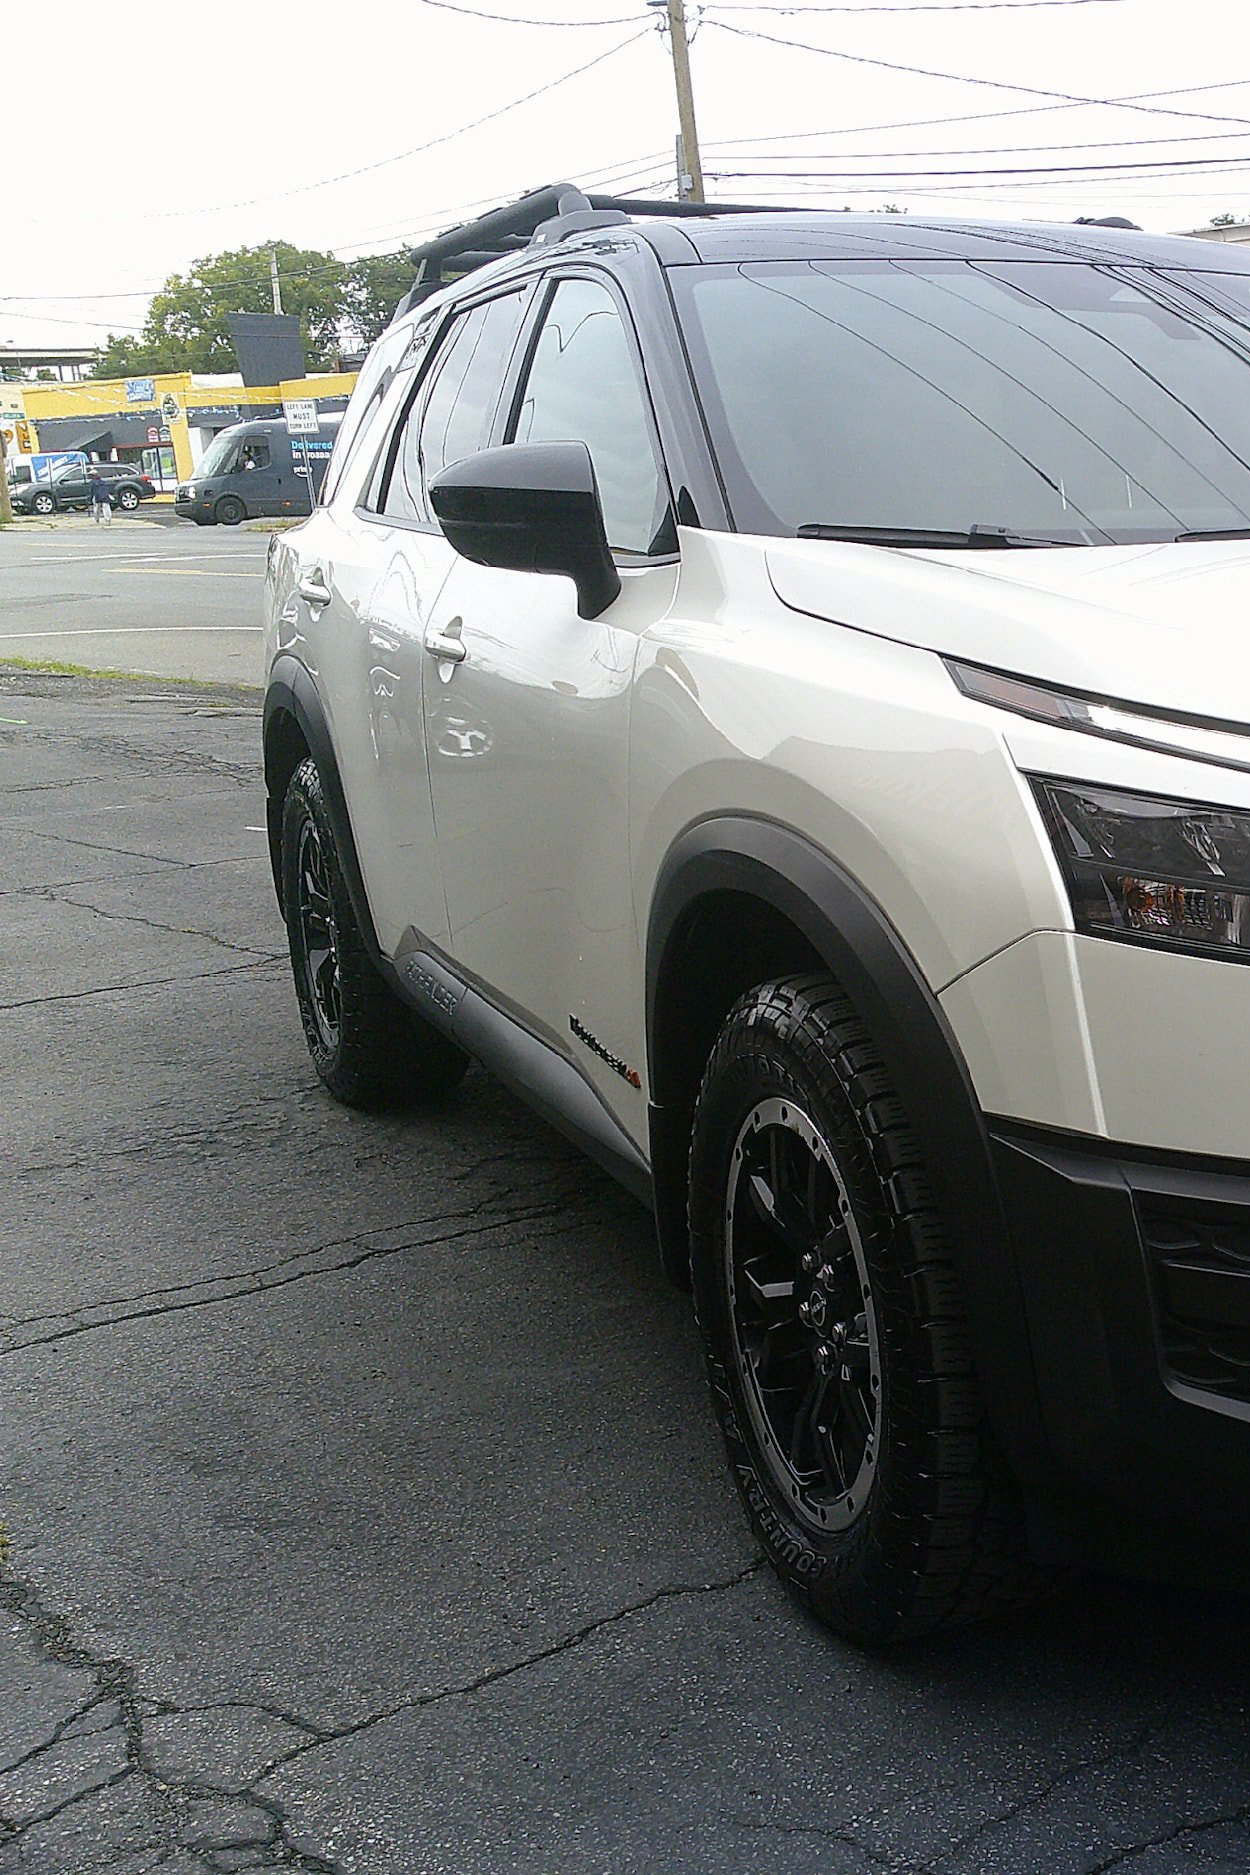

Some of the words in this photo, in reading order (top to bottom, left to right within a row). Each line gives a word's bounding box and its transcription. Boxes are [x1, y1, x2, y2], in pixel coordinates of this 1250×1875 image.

[293, 412, 310, 420] MUST
[291, 440, 333, 450] Deivered
[292, 450, 302, 459] in
[736, 1463, 828, 1578] COUNTRY
